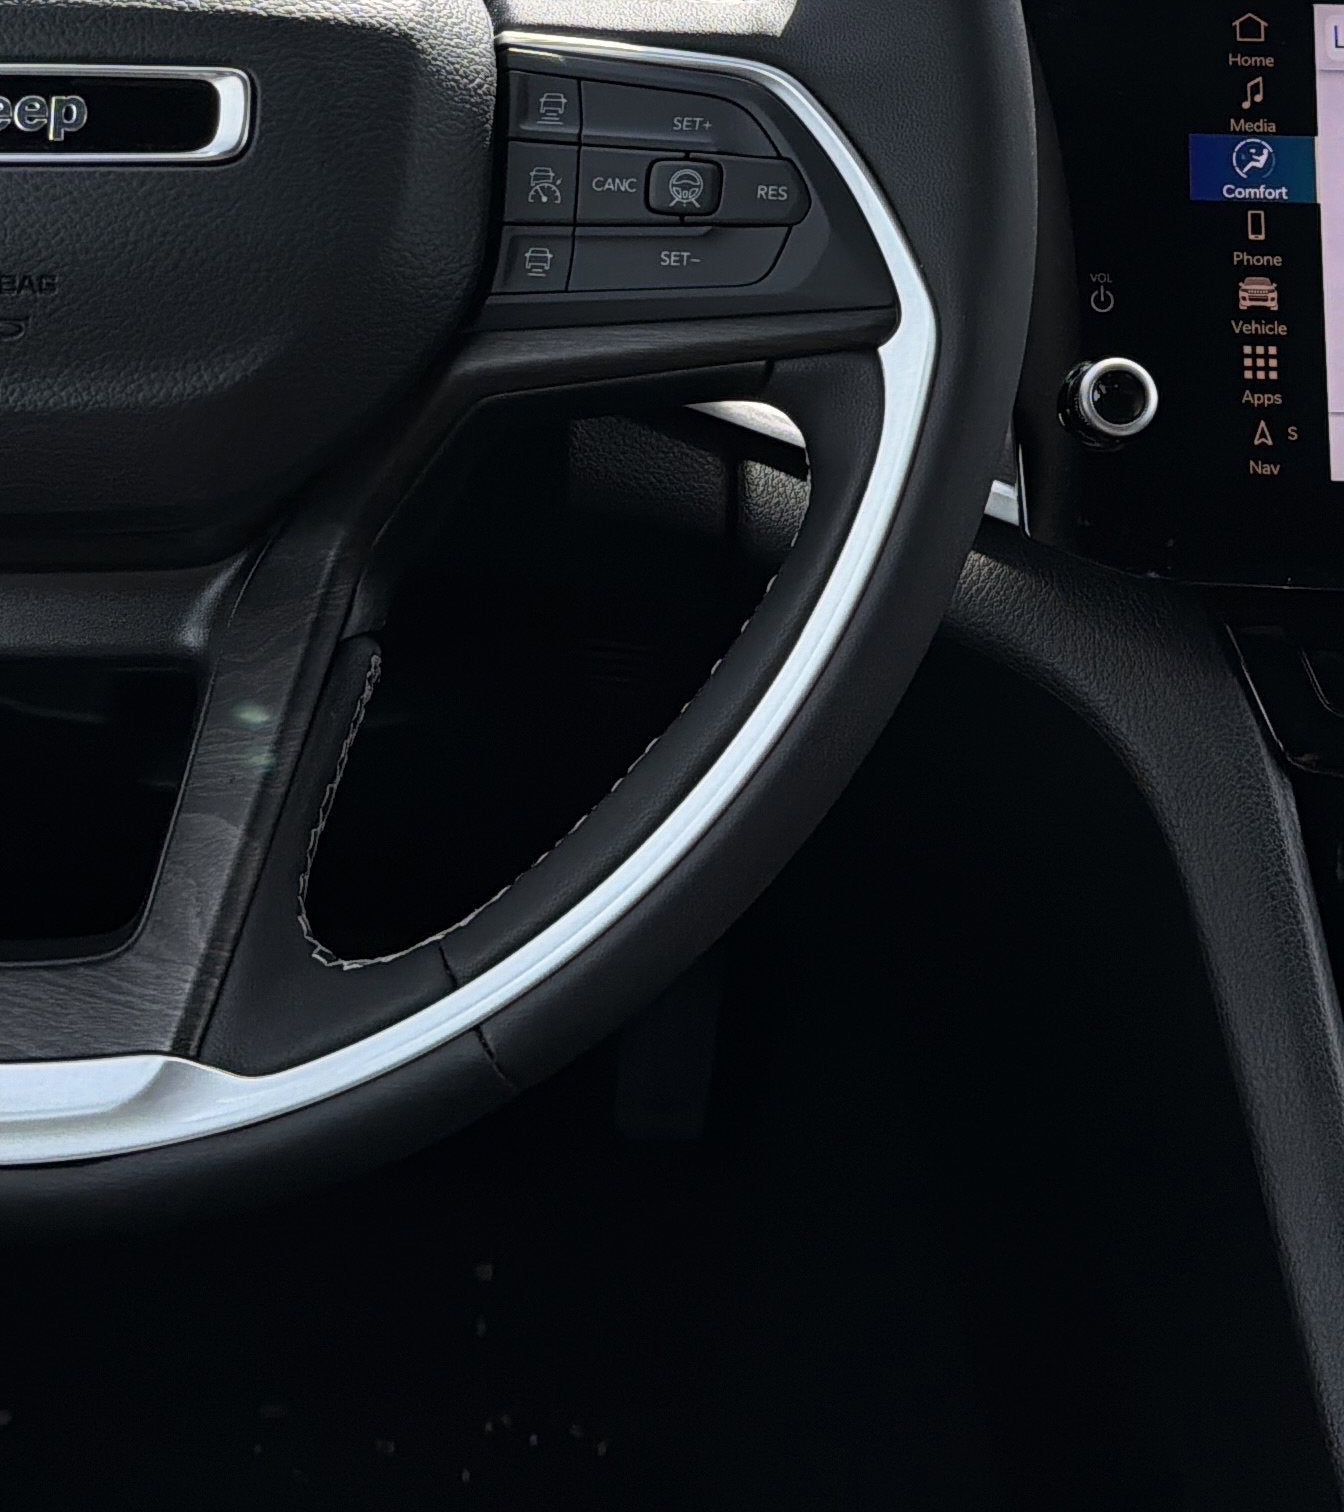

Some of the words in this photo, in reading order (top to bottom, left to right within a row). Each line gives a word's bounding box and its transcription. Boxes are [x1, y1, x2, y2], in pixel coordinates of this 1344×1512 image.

[1228, 53, 1275, 67] Home
[673, 117, 712, 131] SET+
[1230, 119, 1276, 133] Media
[592, 177, 637, 193] CANC
[1222, 184, 1288, 200] Comfort
[757, 186, 788, 201] RES
[1233, 253, 1282, 268] Phone
[1090, 273, 1112, 283] VOL
[1231, 320, 1288, 335] Vehicle
[1242, 391, 1282, 407] Apps
[1288, 426, 1298, 440] S
[1249, 461, 1280, 475] Nav
